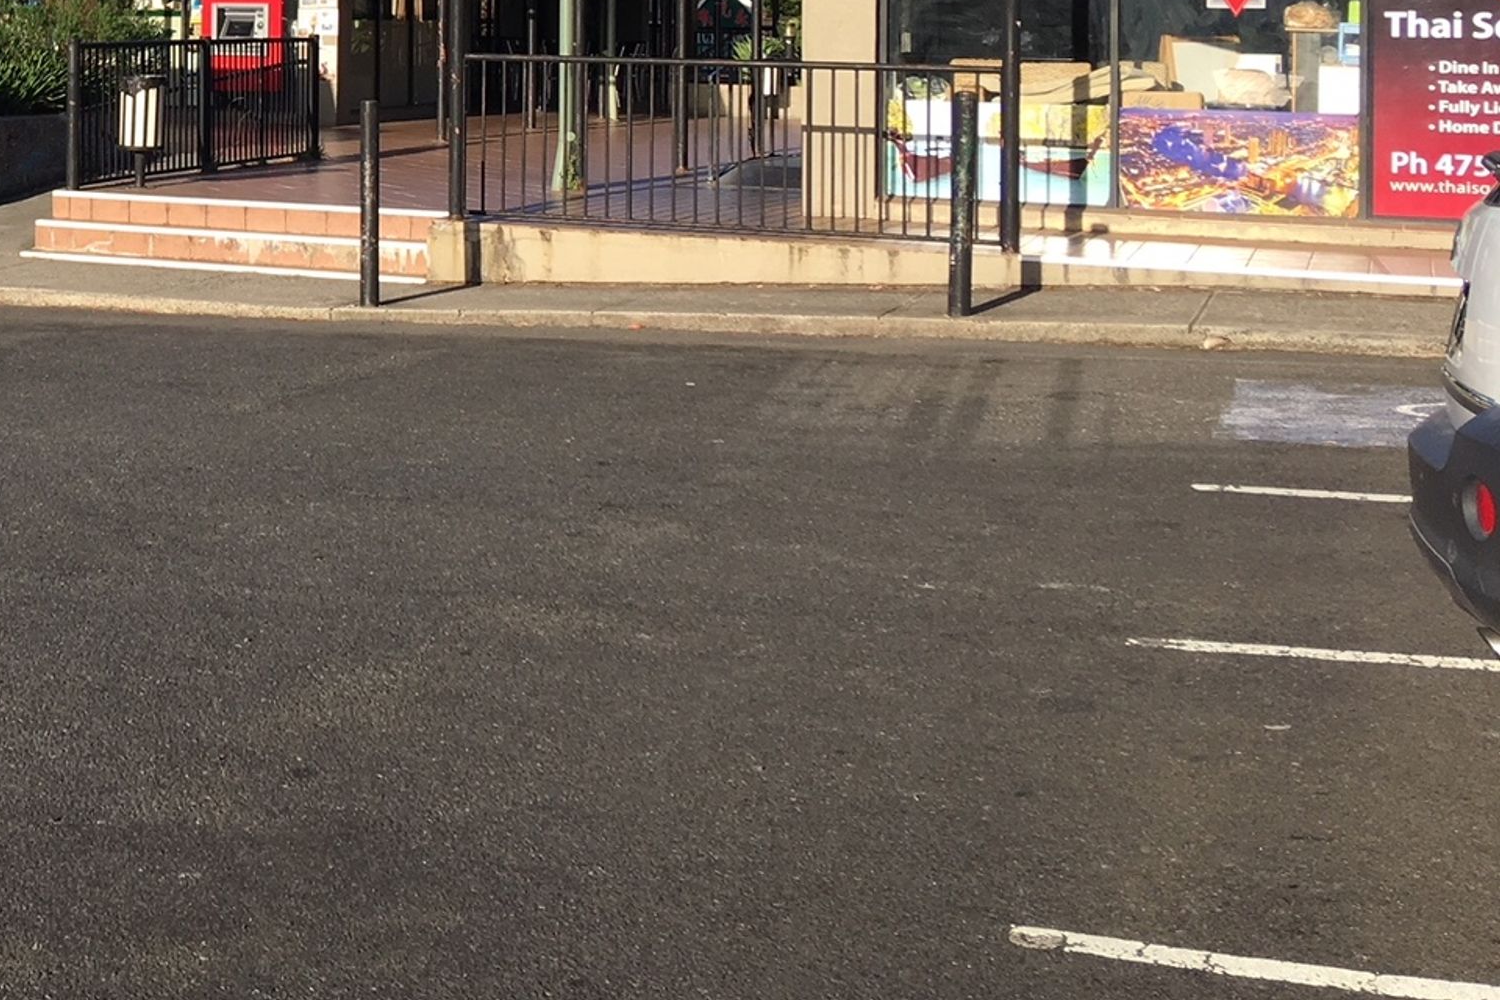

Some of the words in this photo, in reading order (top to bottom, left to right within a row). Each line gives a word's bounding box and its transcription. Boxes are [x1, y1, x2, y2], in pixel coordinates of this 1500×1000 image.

[1383, 10, 1462, 39] Thai
[1438, 60, 1479, 74] Dine
[1482, 61, 1500, 74] In
[1438, 80, 1478, 94] Take
[1439, 100, 1480, 117] Fully
[1483, 101, 1500, 114] Li
[1438, 120, 1490, 134] Home
[1391, 151, 1428, 175] Ph
